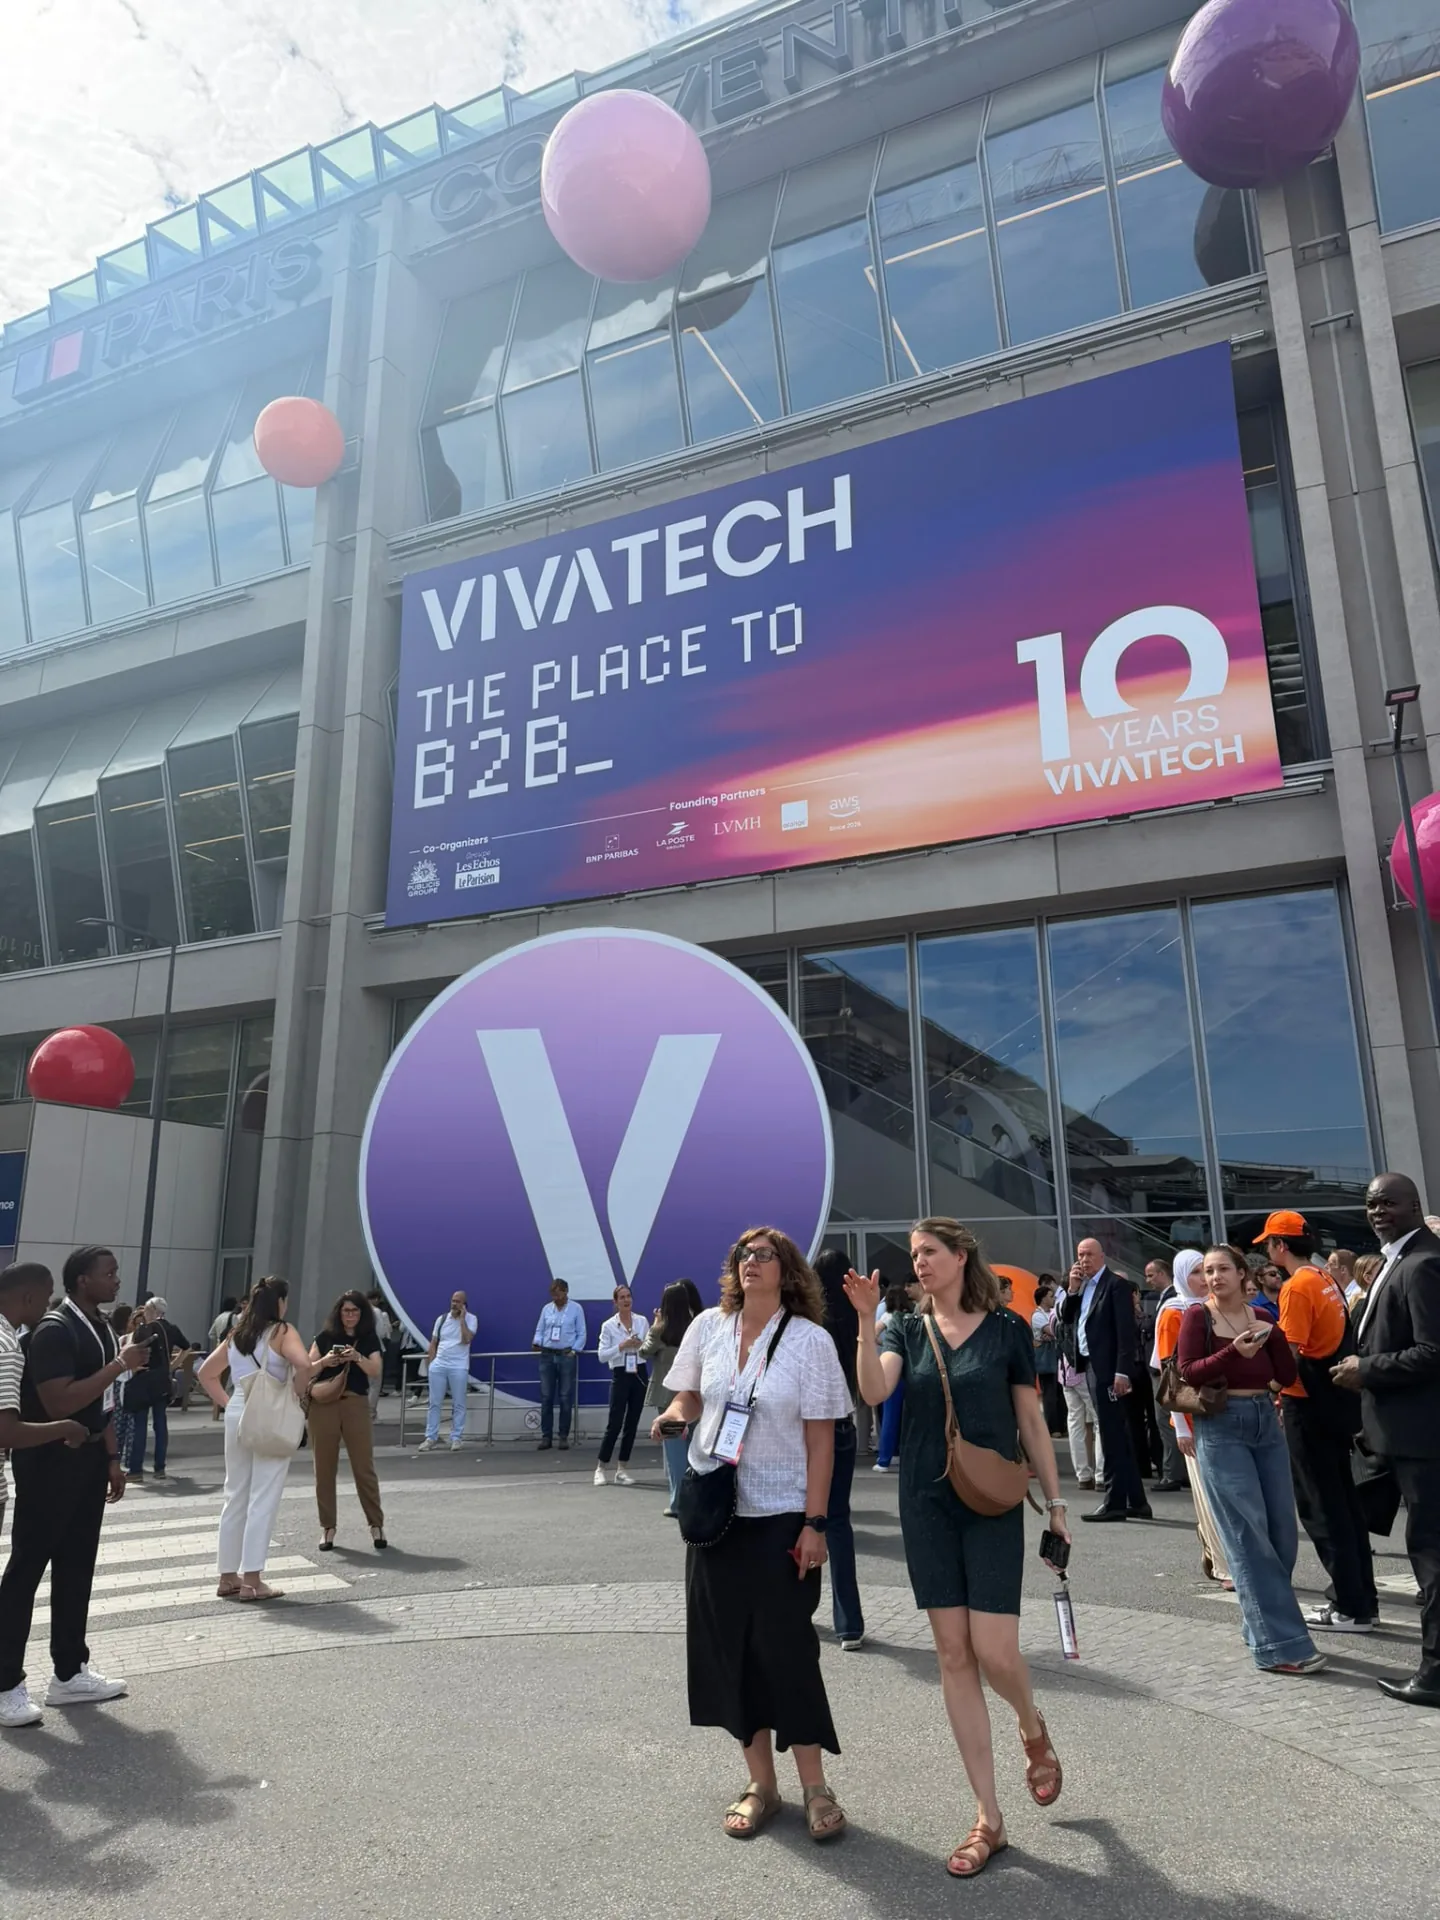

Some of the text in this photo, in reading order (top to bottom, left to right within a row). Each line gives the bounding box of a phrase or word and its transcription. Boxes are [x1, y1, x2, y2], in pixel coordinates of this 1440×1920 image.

[101, 235, 311, 360] PARIS
[421, 473, 852, 651] VIVATECH
[416, 602, 802, 732] THE PLACE TO
[1016, 605, 1229, 763] 10
[1099, 704, 1220, 750] YEARS
[1043, 734, 1245, 796] VIVATECH
[669, 787, 766, 811] Founding Partners
[829, 795, 859, 811] aws
[713, 816, 762, 836] LVMH
[423, 836, 489, 854] Co-Organizers
[656, 834, 695, 848] LA POSTE
[586, 848, 639, 864] BNP PARIBAS
[407, 880, 440, 891] PUBLICIS
[408, 888, 438, 897] GROUPE
[476, 1028, 722, 1300] V
